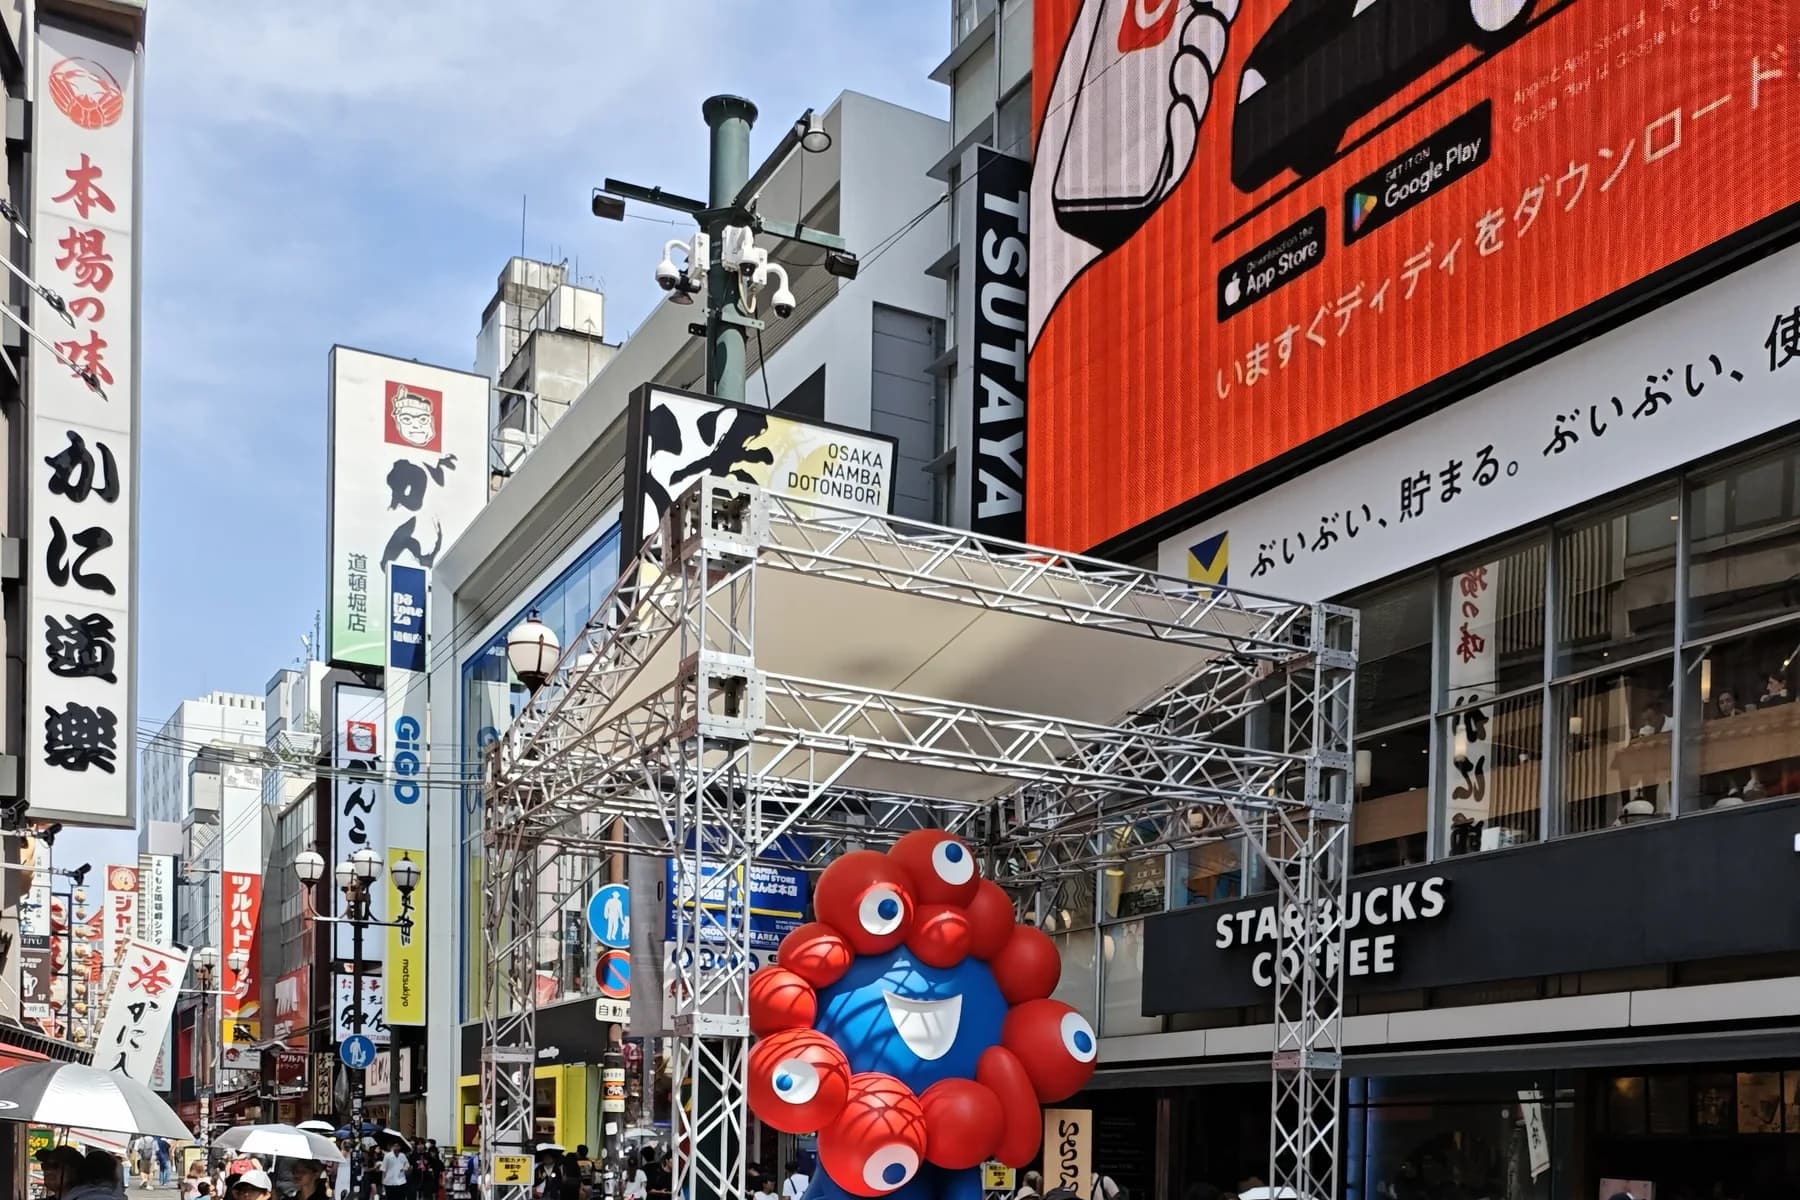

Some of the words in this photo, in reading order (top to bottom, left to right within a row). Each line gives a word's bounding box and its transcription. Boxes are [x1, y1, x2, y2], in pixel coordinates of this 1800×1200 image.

[1384, 161, 1443, 208] Google
[1445, 137, 1482, 172] Play
[51, 152, 116, 392] 本場の味
[1245, 265, 1276, 297] App
[1277, 239, 1319, 277] Store
[978, 190, 1029, 519] TSUTAYA
[788, 471, 881, 507] DOTONBORI
[823, 460, 882, 489] NAMBA
[828, 442, 884, 470] OSAKA
[1249, 444, 1519, 579] ぶいぶい、貯まる。
[347, 552, 369, 634] 道頓堀店
[394, 715, 421, 805] GiGO
[1216, 876, 1446, 949] STARBUCKS
[401, 958, 410, 1008] matsukiyo
